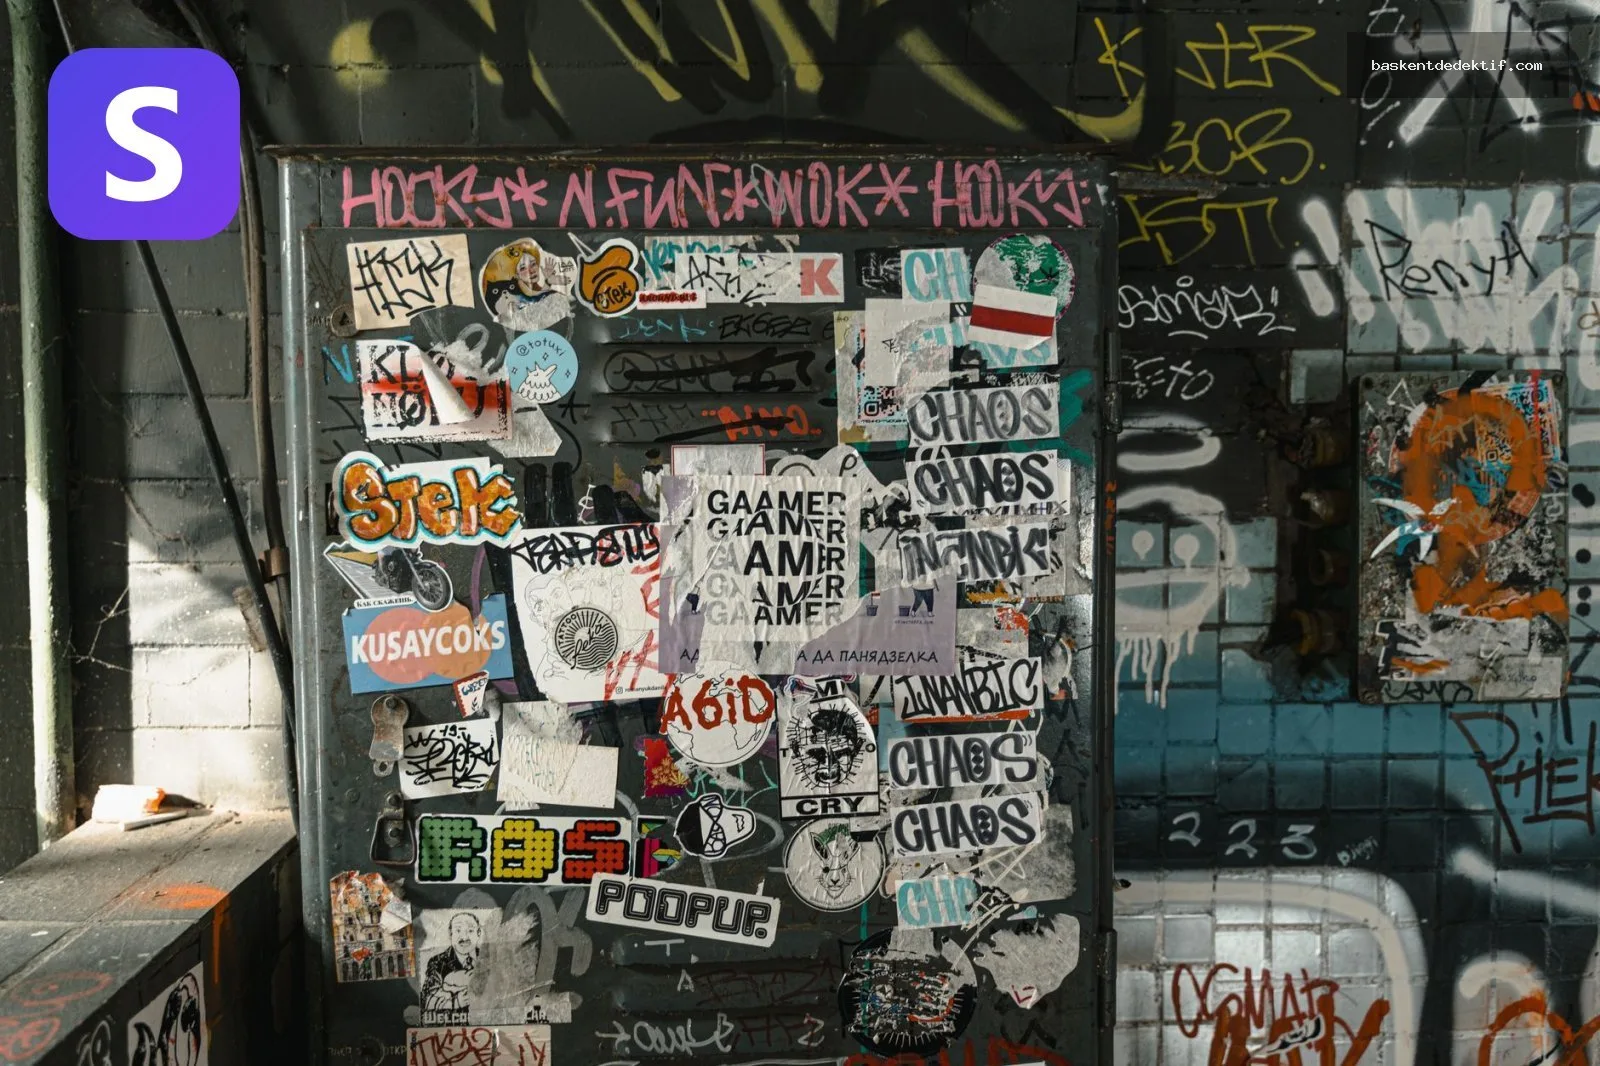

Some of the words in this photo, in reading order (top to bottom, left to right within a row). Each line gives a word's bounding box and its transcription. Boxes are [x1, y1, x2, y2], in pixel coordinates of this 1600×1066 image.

[914, 453, 1055, 507] CHAOS
[351, 621, 506, 665] KUSAYCOKS
[558, 613, 577, 647] TATTOO
[839, 650, 938, 664] ПАНЯДЗЕЛКА
[889, 732, 1038, 787] CHAOS
[796, 797, 864, 815] CRY
[894, 797, 1036, 852] CHAOS
